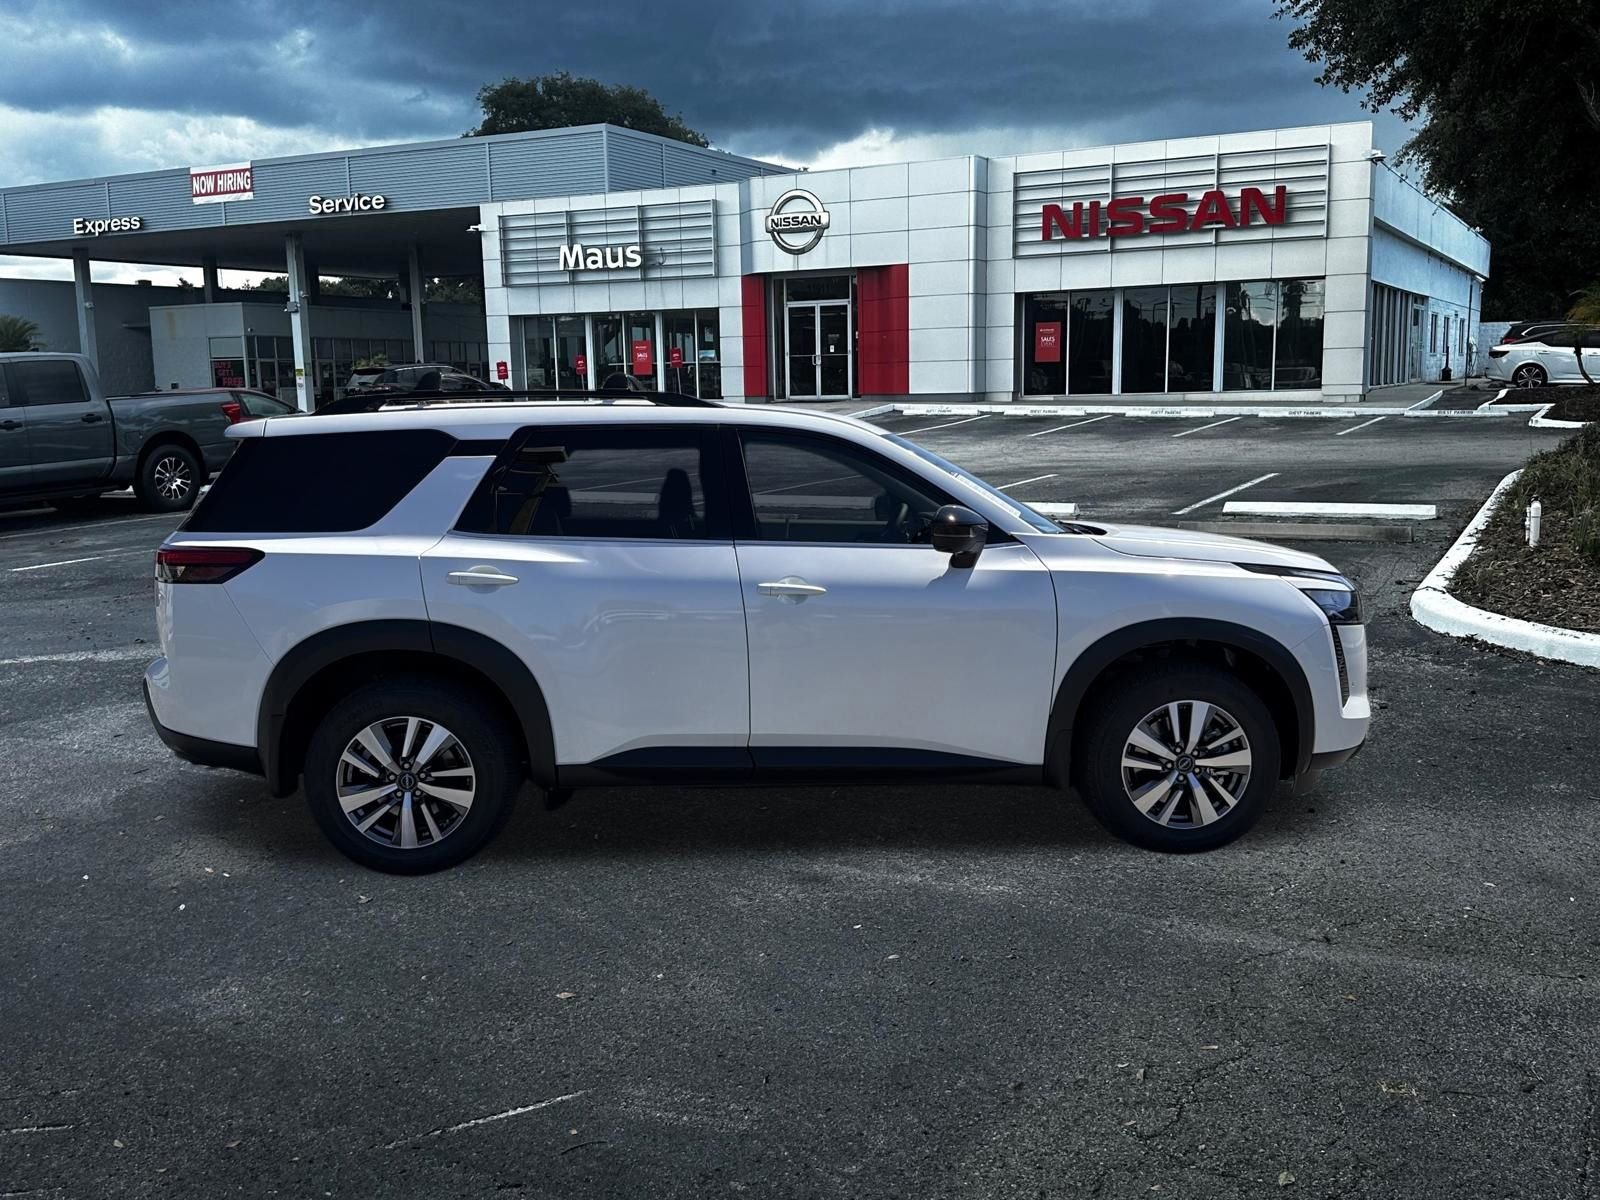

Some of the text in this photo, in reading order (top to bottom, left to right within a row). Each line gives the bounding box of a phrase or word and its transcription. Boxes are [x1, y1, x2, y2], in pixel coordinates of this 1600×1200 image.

[192, 171, 251, 195] NOW HIRING
[308, 193, 386, 215] Service
[1042, 185, 1287, 241] NISSAN
[73, 216, 142, 236] Express
[770, 215, 822, 229] NISSAN
[559, 243, 642, 271] Maus
